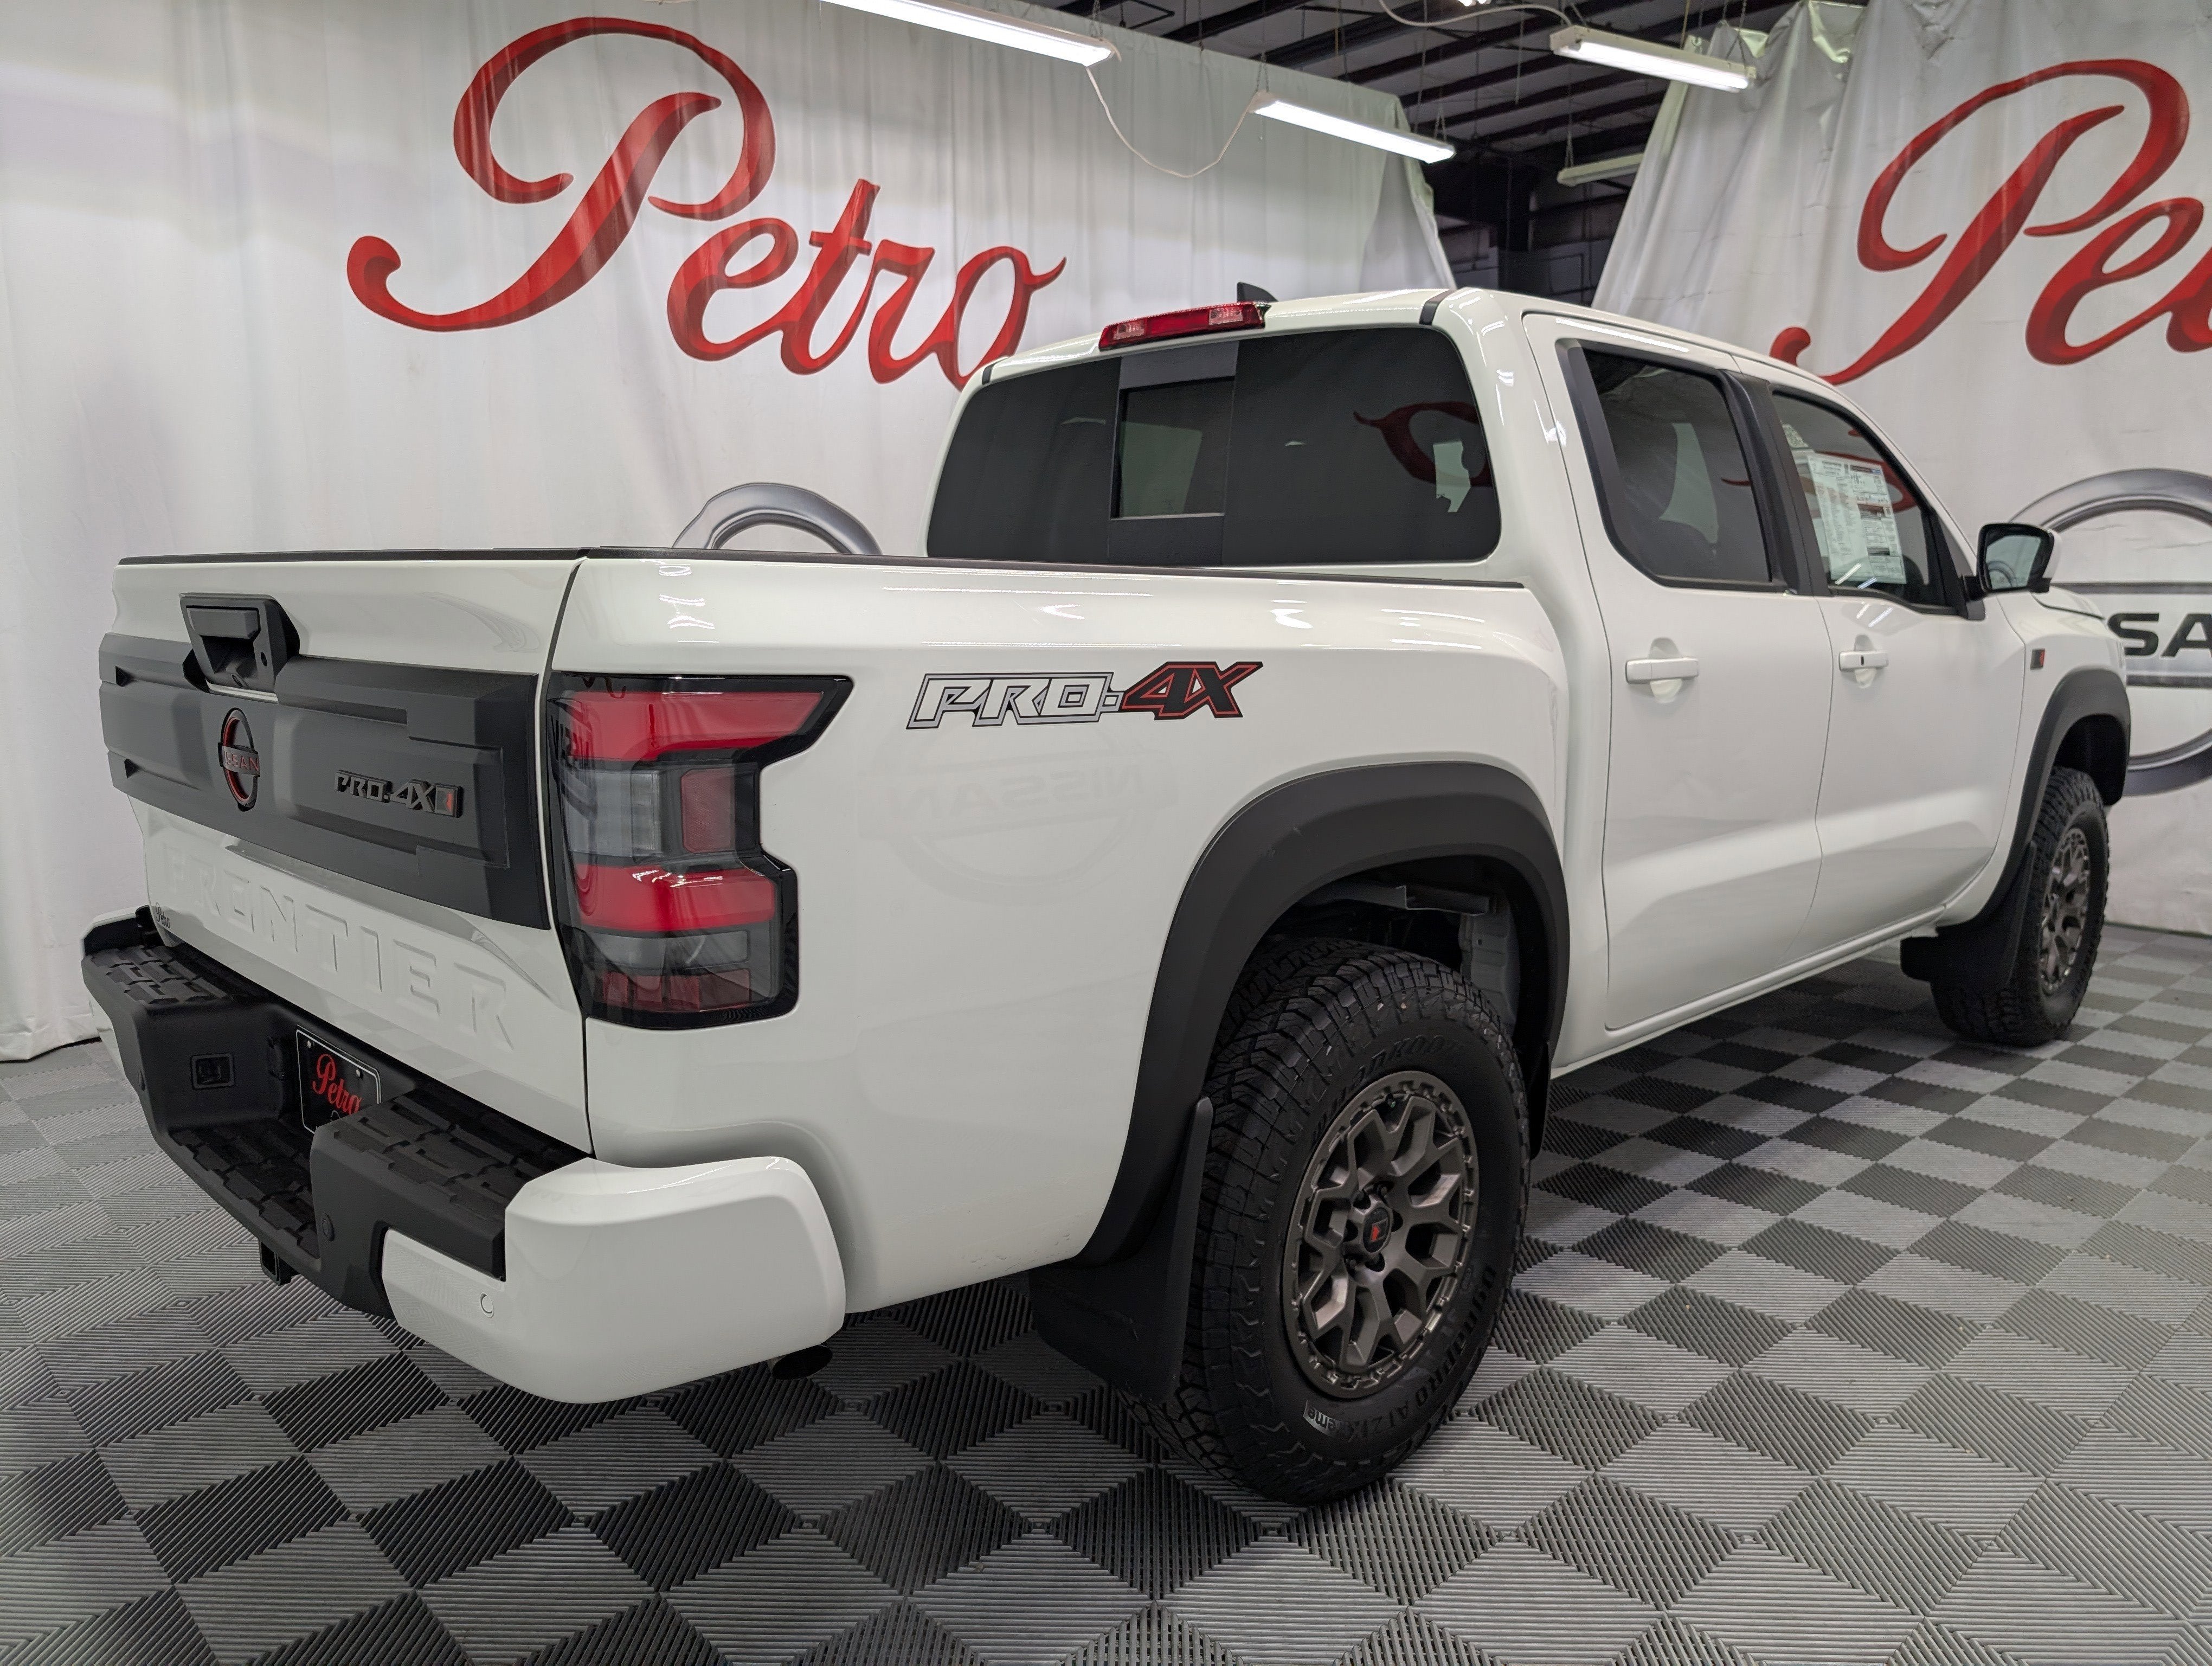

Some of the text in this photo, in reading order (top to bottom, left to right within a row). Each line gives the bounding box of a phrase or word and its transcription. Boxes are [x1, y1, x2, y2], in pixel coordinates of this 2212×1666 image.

[347, 16, 1066, 392] Petro
[905, 661, 1264, 729] PRO-4X
[312, 1054, 362, 1116] Petro
